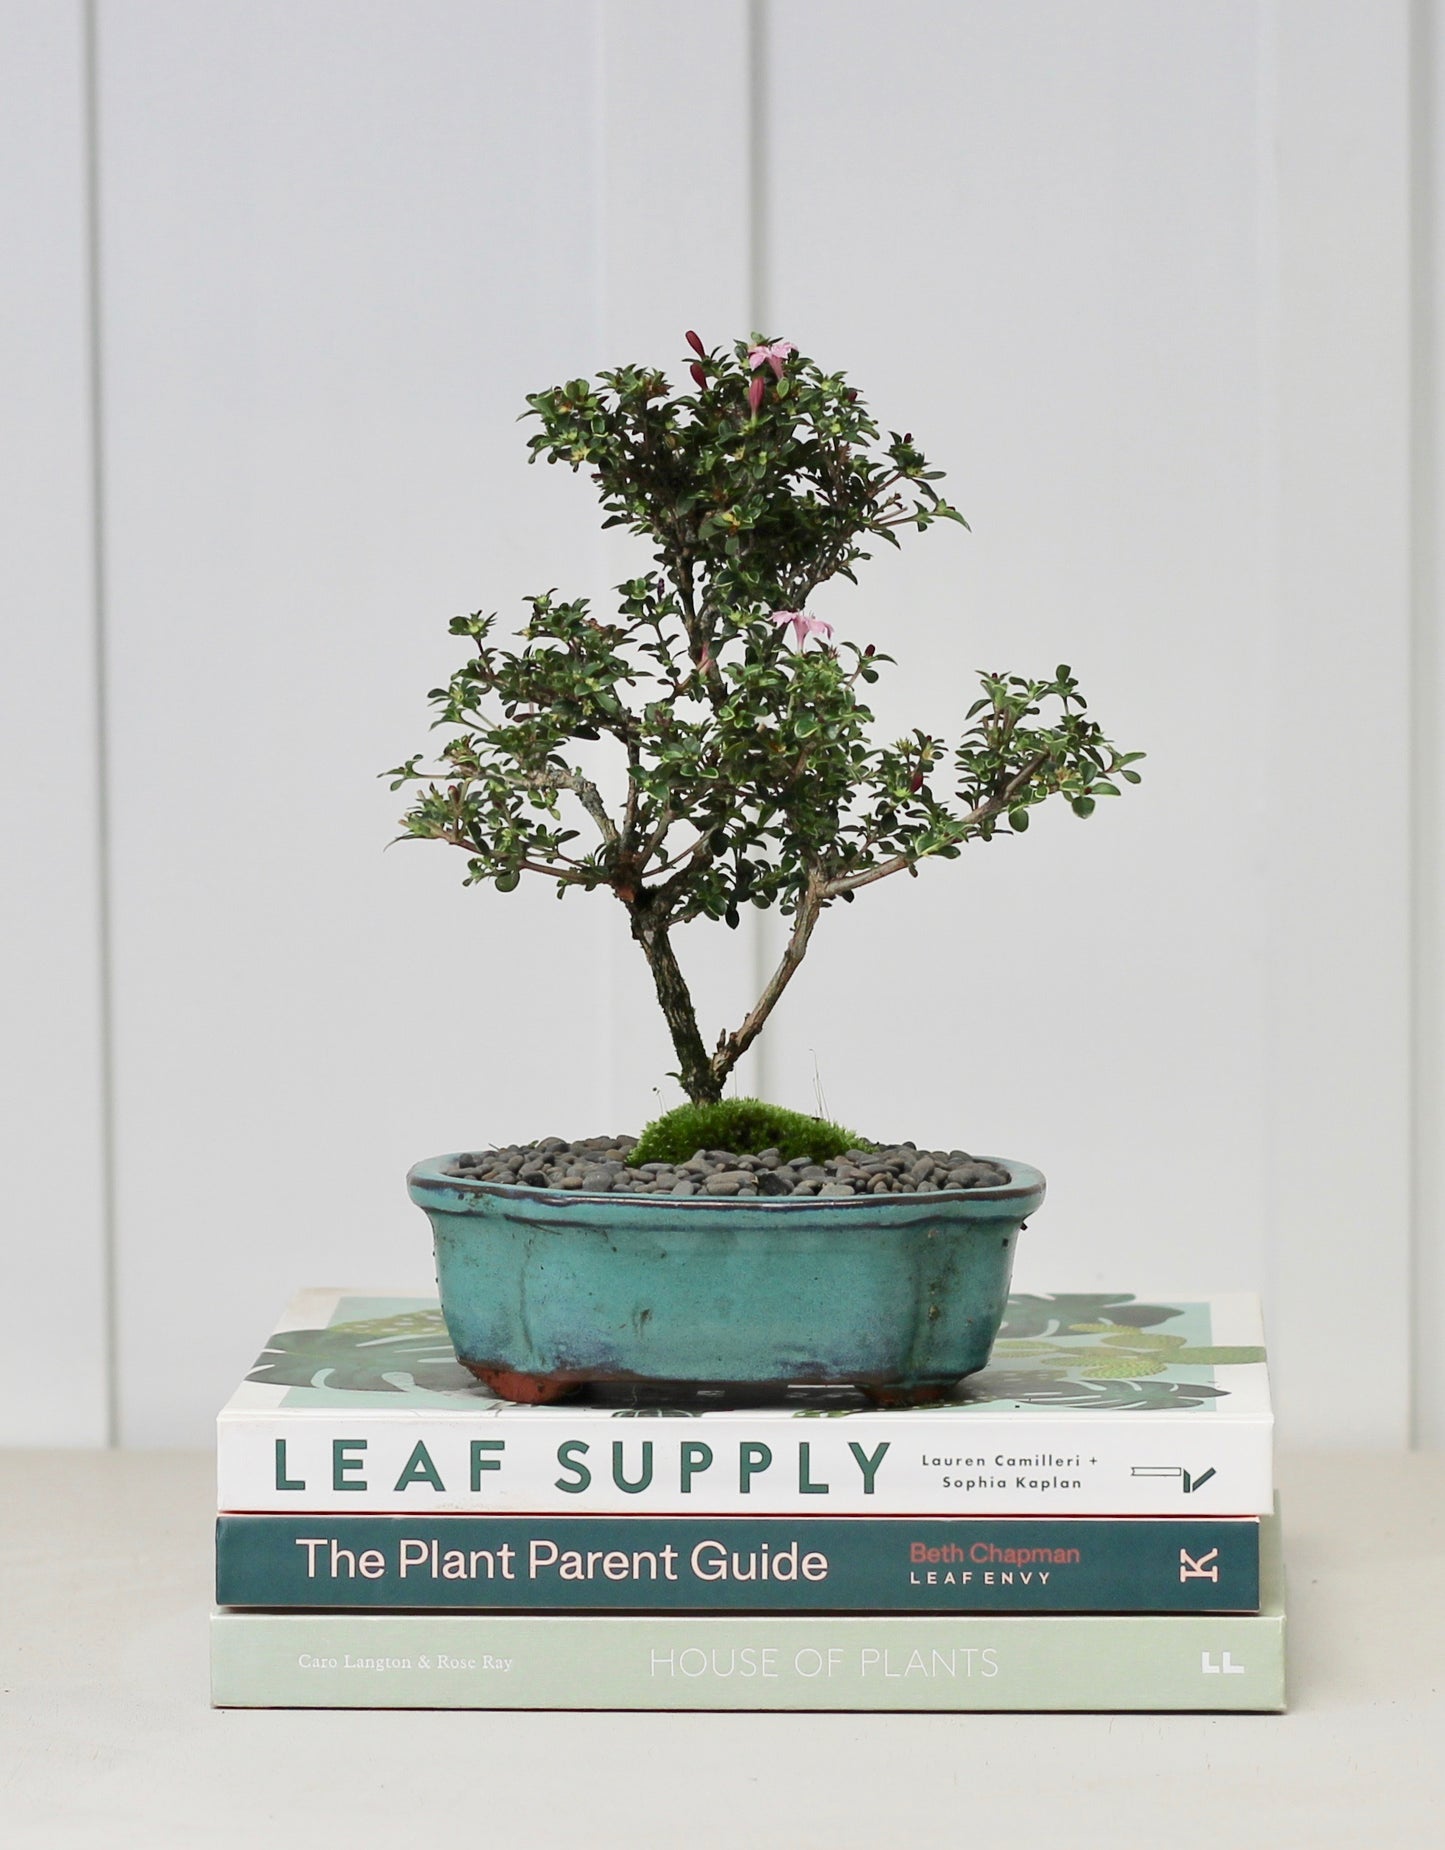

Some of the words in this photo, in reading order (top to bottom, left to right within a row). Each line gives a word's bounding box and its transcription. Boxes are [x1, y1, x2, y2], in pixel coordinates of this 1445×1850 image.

[275, 1439, 505, 1492] LEAF
[555, 1440, 891, 1494] SUPPLY
[922, 1454, 986, 1467] Lauren
[995, 1453, 1081, 1467] Camilleri
[942, 1476, 1007, 1491] Sophia
[1016, 1475, 1082, 1491] Kaplan
[296, 1538, 386, 1579] The
[399, 1539, 516, 1580] Plant
[529, 1541, 679, 1582] Parent
[690, 1541, 830, 1582] Guide
[910, 1543, 964, 1564] Beth
[970, 1543, 1081, 1567] Chapman
[910, 1572, 975, 1585] LEAF
[984, 1572, 1051, 1585] ENVY
[298, 1654, 338, 1669] Caro
[344, 1654, 412, 1673] Langton
[418, 1655, 431, 1670] &
[437, 1655, 476, 1670] Rose
[482, 1655, 513, 1674] Ray
[650, 1648, 780, 1678] HOUSE
[794, 1648, 844, 1678] OF
[861, 1648, 1000, 1678] PLANTS
